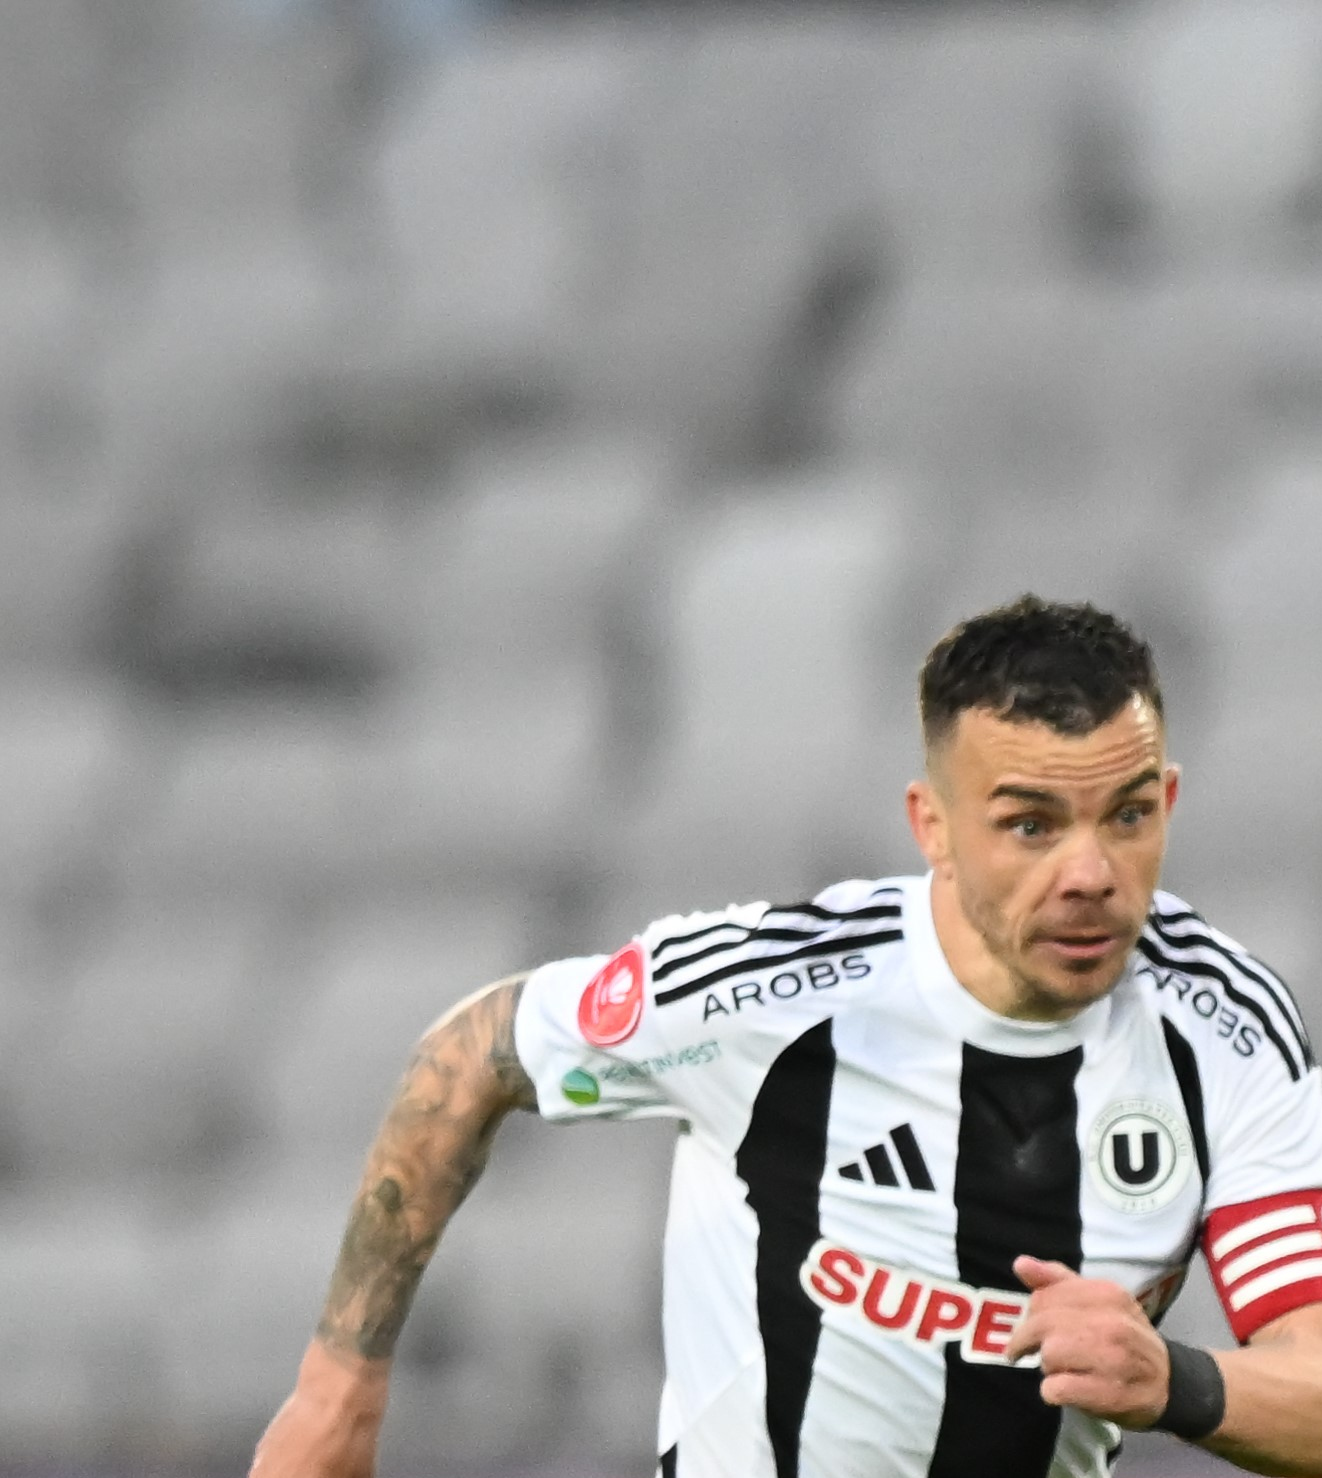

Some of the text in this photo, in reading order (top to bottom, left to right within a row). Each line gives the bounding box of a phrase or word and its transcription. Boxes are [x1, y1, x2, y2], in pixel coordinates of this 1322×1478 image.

[703, 954, 871, 1023] AROBS
[1112, 1131, 1159, 1185] U
[811, 1249, 1022, 1354] SUPE
